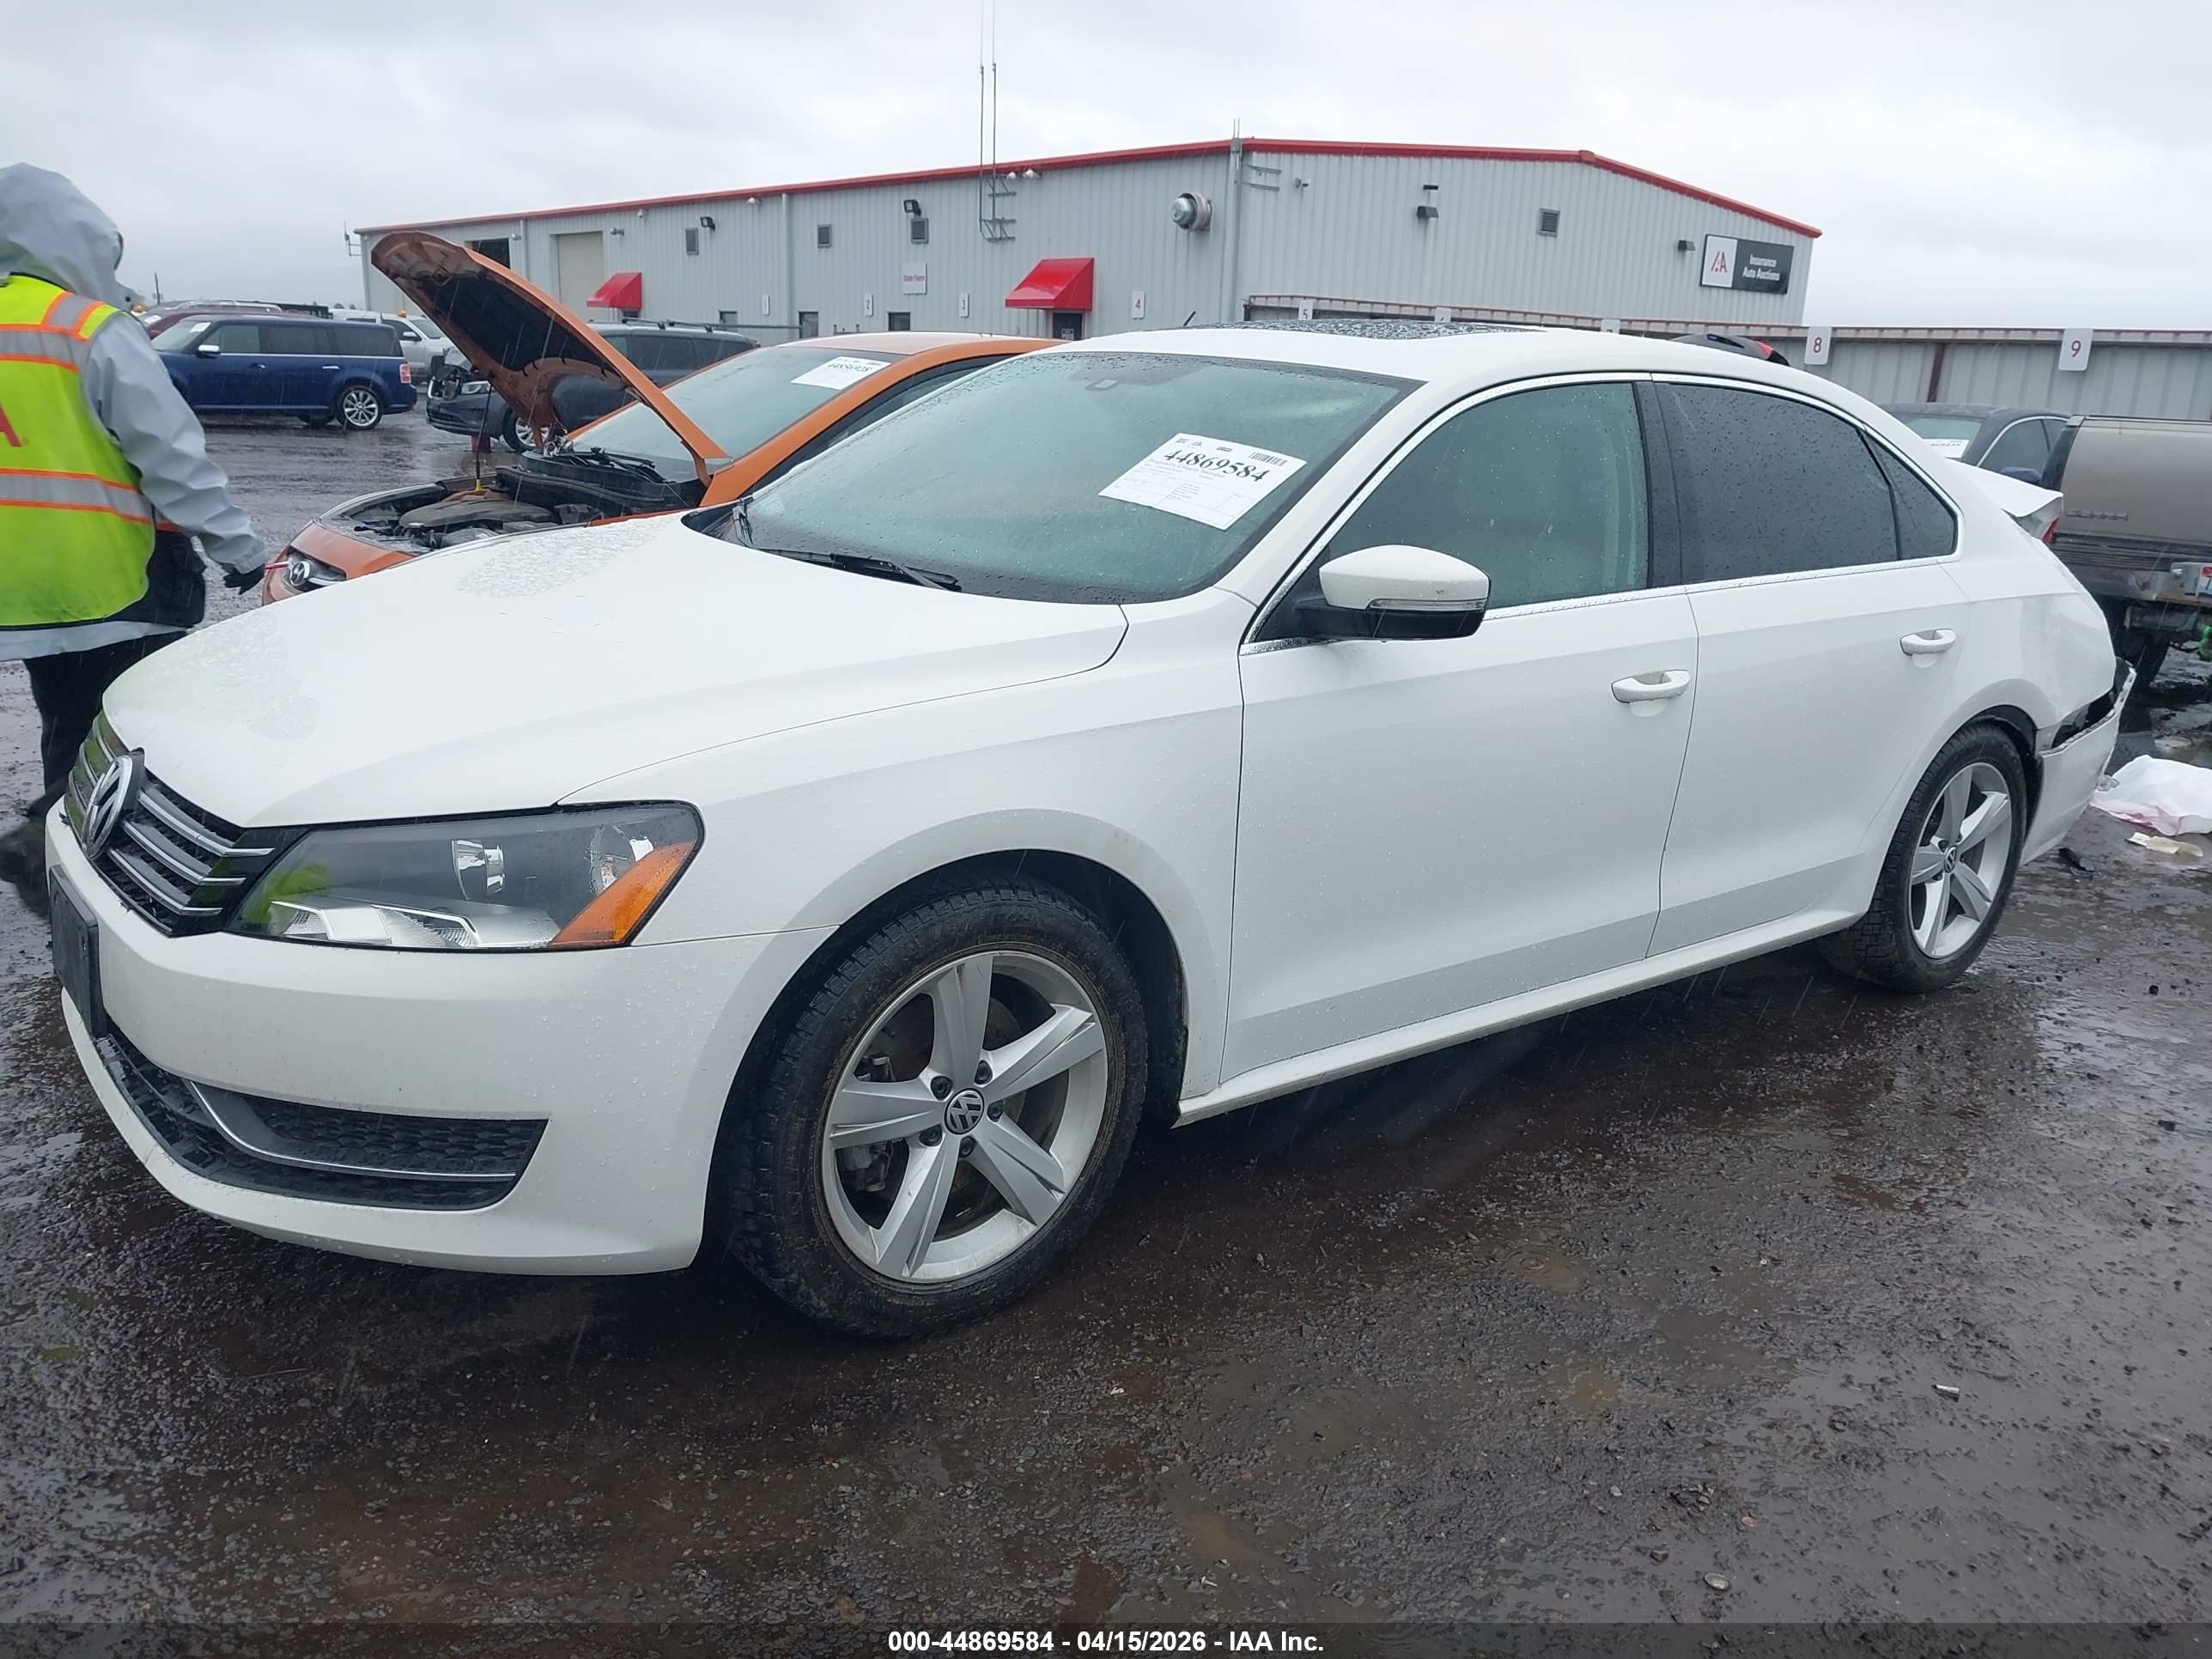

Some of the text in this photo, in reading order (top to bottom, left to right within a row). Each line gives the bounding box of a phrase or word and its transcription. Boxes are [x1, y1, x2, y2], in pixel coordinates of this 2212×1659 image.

[1135, 298, 1141, 310] 4
[1813, 337, 1822, 354] 8
[2070, 340, 2081, 358] 9
[1164, 449, 1271, 482] 44869584
